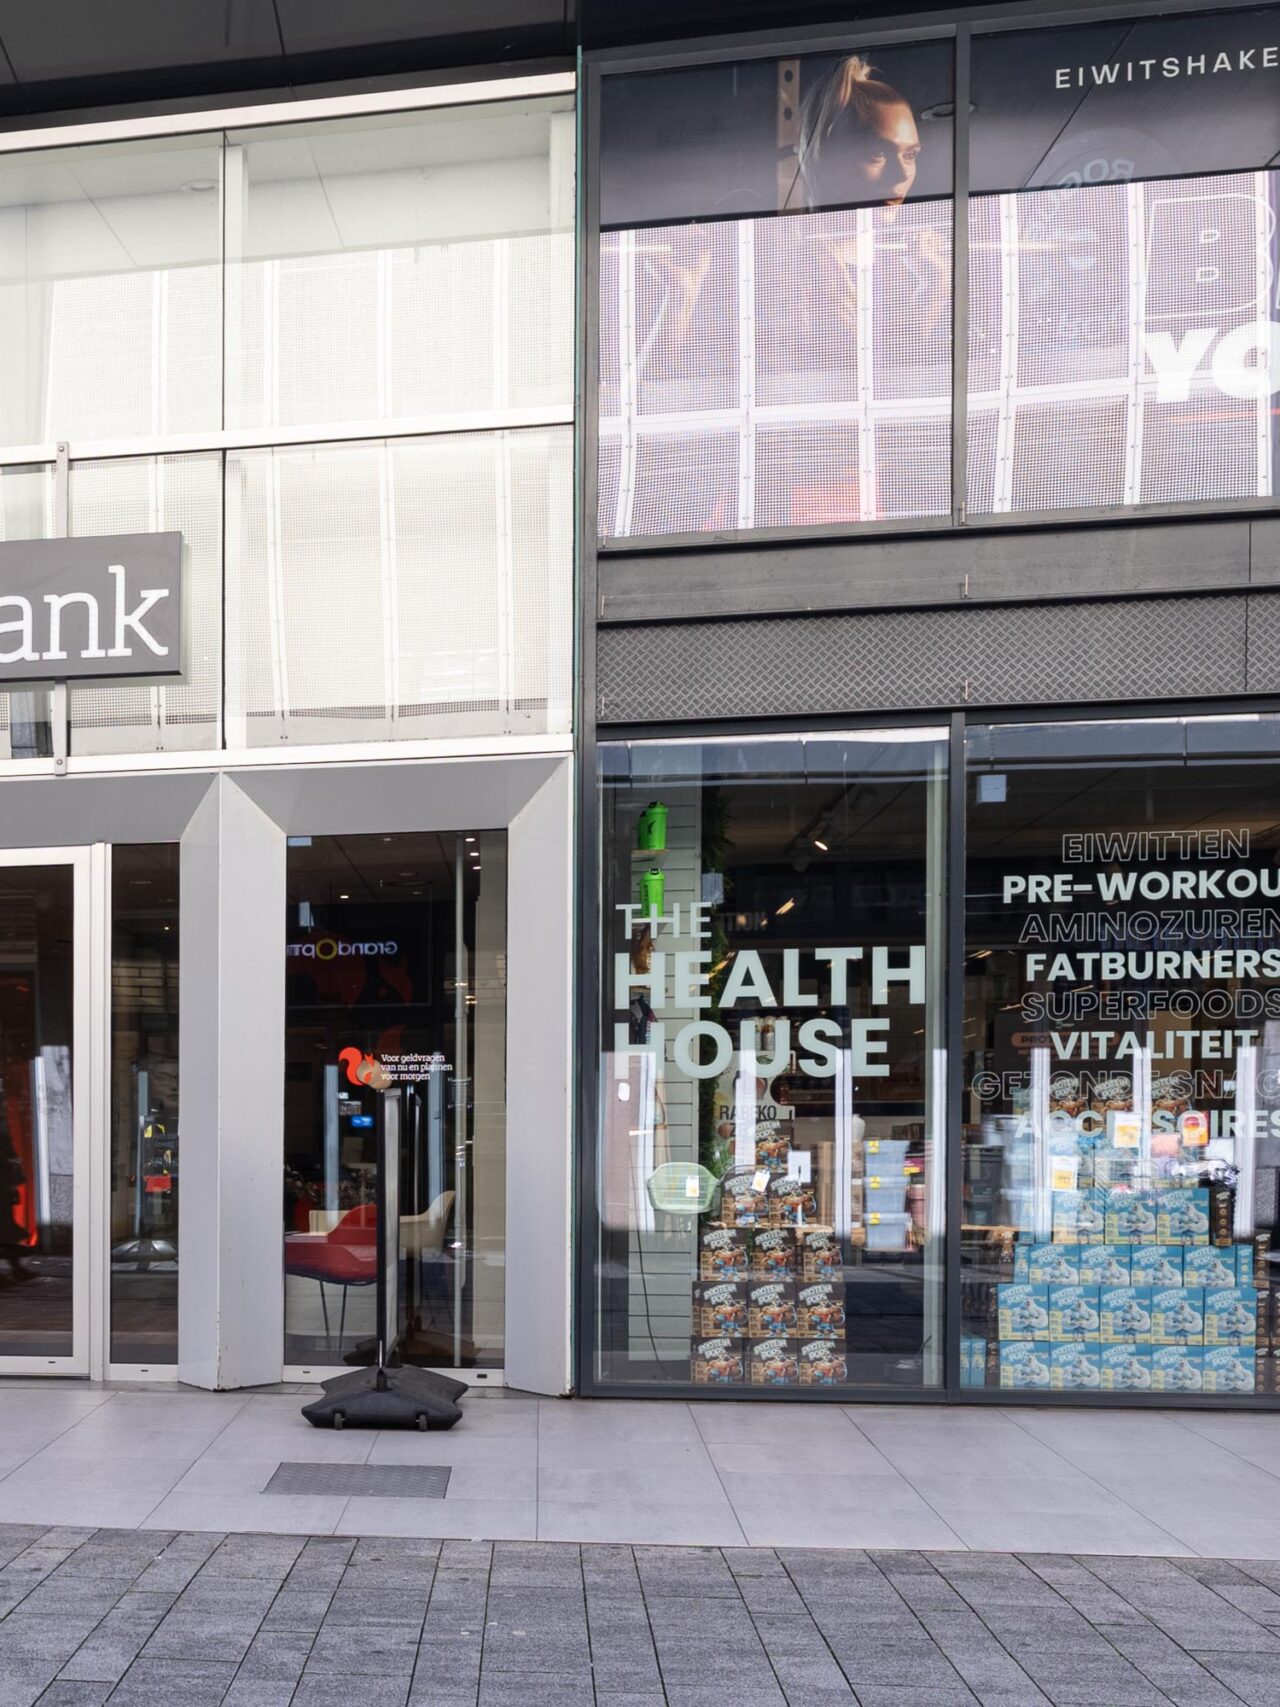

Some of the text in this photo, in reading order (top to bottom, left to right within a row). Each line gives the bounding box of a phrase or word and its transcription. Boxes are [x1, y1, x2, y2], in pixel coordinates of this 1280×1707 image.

[1062, 829, 1250, 863] EIWITTEN
[616, 902, 712, 939] THE
[1019, 908, 1280, 943] AMINOZUREN
[614, 945, 926, 1010] HEALTH
[1026, 948, 1280, 982] FATBURNERS
[1021, 988, 1280, 1022] SUPERFOODS
[381, 1054, 445, 1063] Voor geldvragen
[614, 1018, 890, 1079] HOUSE
[1050, 1029, 1259, 1060] VITALITEIT
[400, 1073, 430, 1081] morgen
[420, 1063, 453, 1072] plannen
[1015, 1109, 1280, 1139] ACCSOIRE
